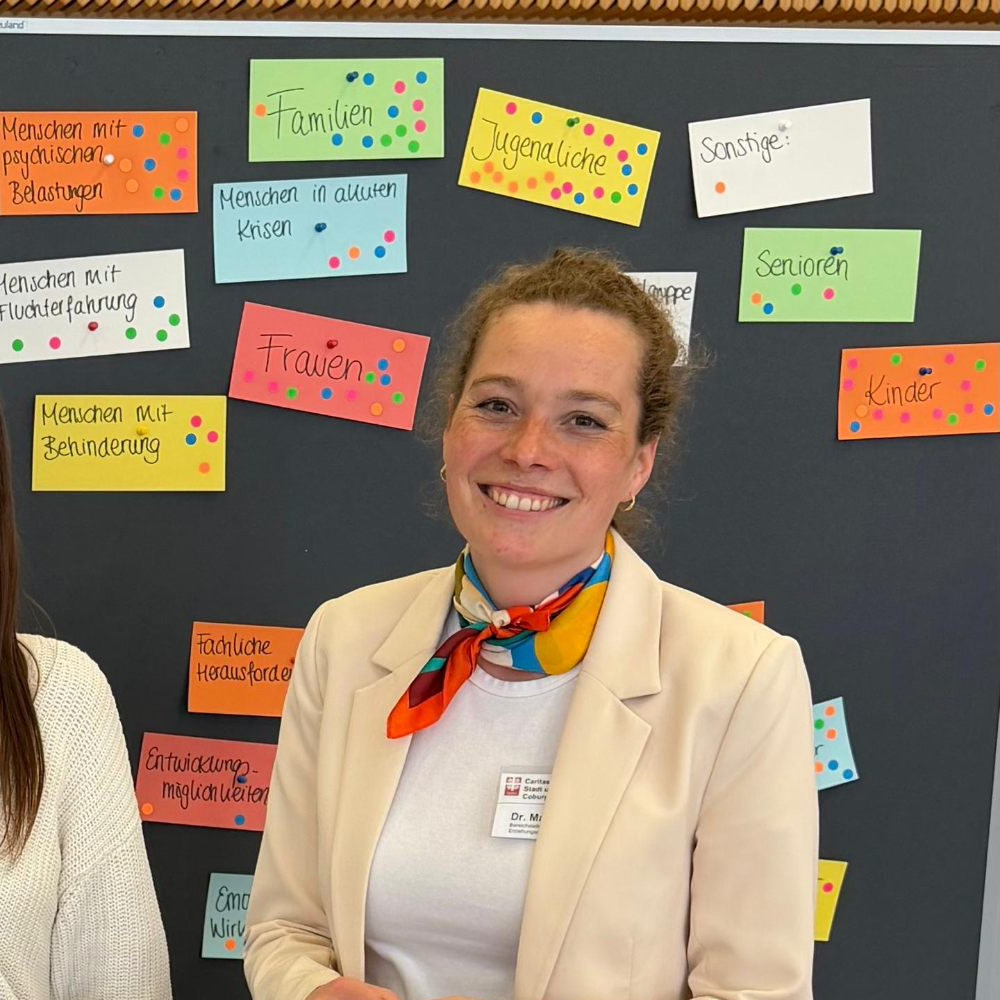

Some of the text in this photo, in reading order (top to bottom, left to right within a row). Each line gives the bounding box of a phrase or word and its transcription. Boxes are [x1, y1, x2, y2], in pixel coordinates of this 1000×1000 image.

[267, 88, 373, 140] Familien
[2, 116, 127, 142] Menschen mit
[3, 145, 104, 180] psychischen
[699, 132, 791, 164] Sonstige:
[9, 180, 103, 212] Belastungen
[219, 181, 398, 210] Menschen in akuten
[237, 218, 292, 242] Krisen
[85, 264, 122, 287] mit
[755, 249, 850, 281] Senioren
[257, 333, 363, 381] Frauen
[865, 374, 942, 406] Kinder
[42, 402, 123, 426] Menschen
[41, 435, 161, 464] Behinderung
[196, 633, 273, 658] Fachliche
[511, 812, 526, 821] Dr.
